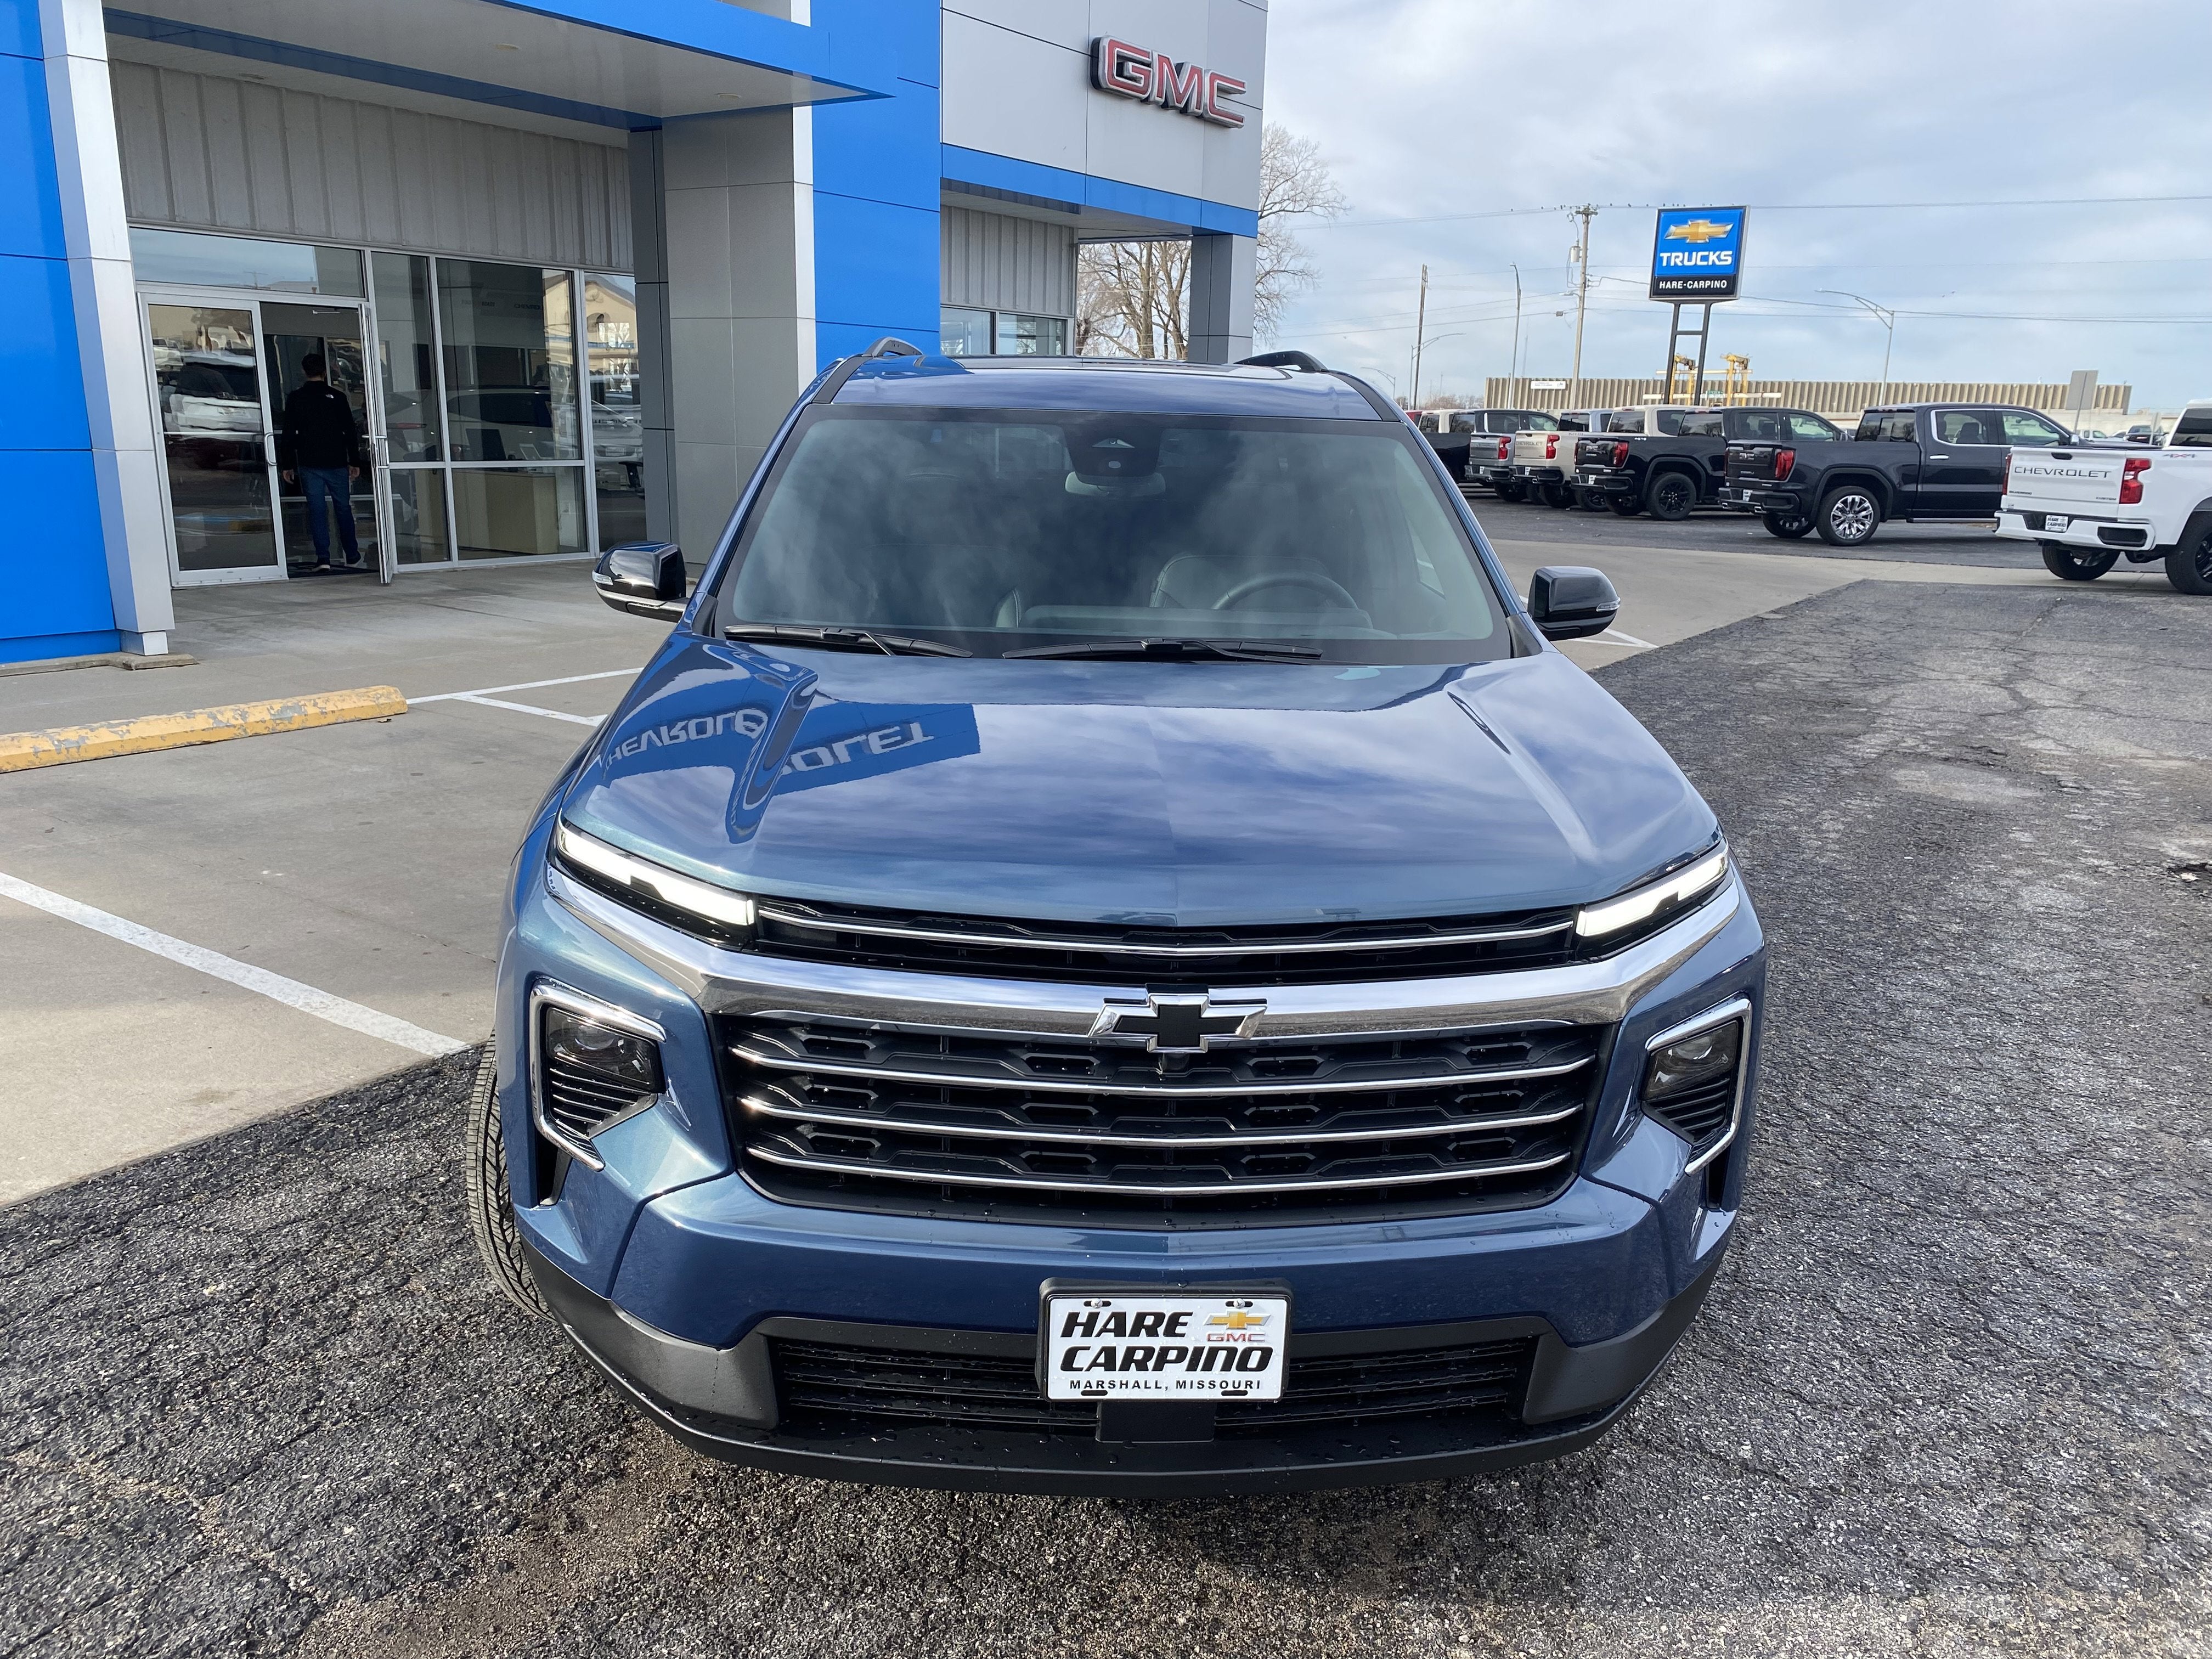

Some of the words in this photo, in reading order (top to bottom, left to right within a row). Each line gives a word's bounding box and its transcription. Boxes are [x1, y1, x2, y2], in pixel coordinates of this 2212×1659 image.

[1092, 35, 1246, 128] GMC
[1660, 251, 1733, 267] TRUCKS
[1659, 280, 1728, 289] HARE-CARPINO
[2014, 466, 2111, 478] CHEVROLET
[1060, 1311, 1194, 1338] HARE
[1206, 1332, 1266, 1342] GMC
[1060, 1346, 1274, 1372] CARPINO
[1069, 1379, 1169, 1391] MARSHALL,
[1175, 1379, 1261, 1390] MISSOURI
